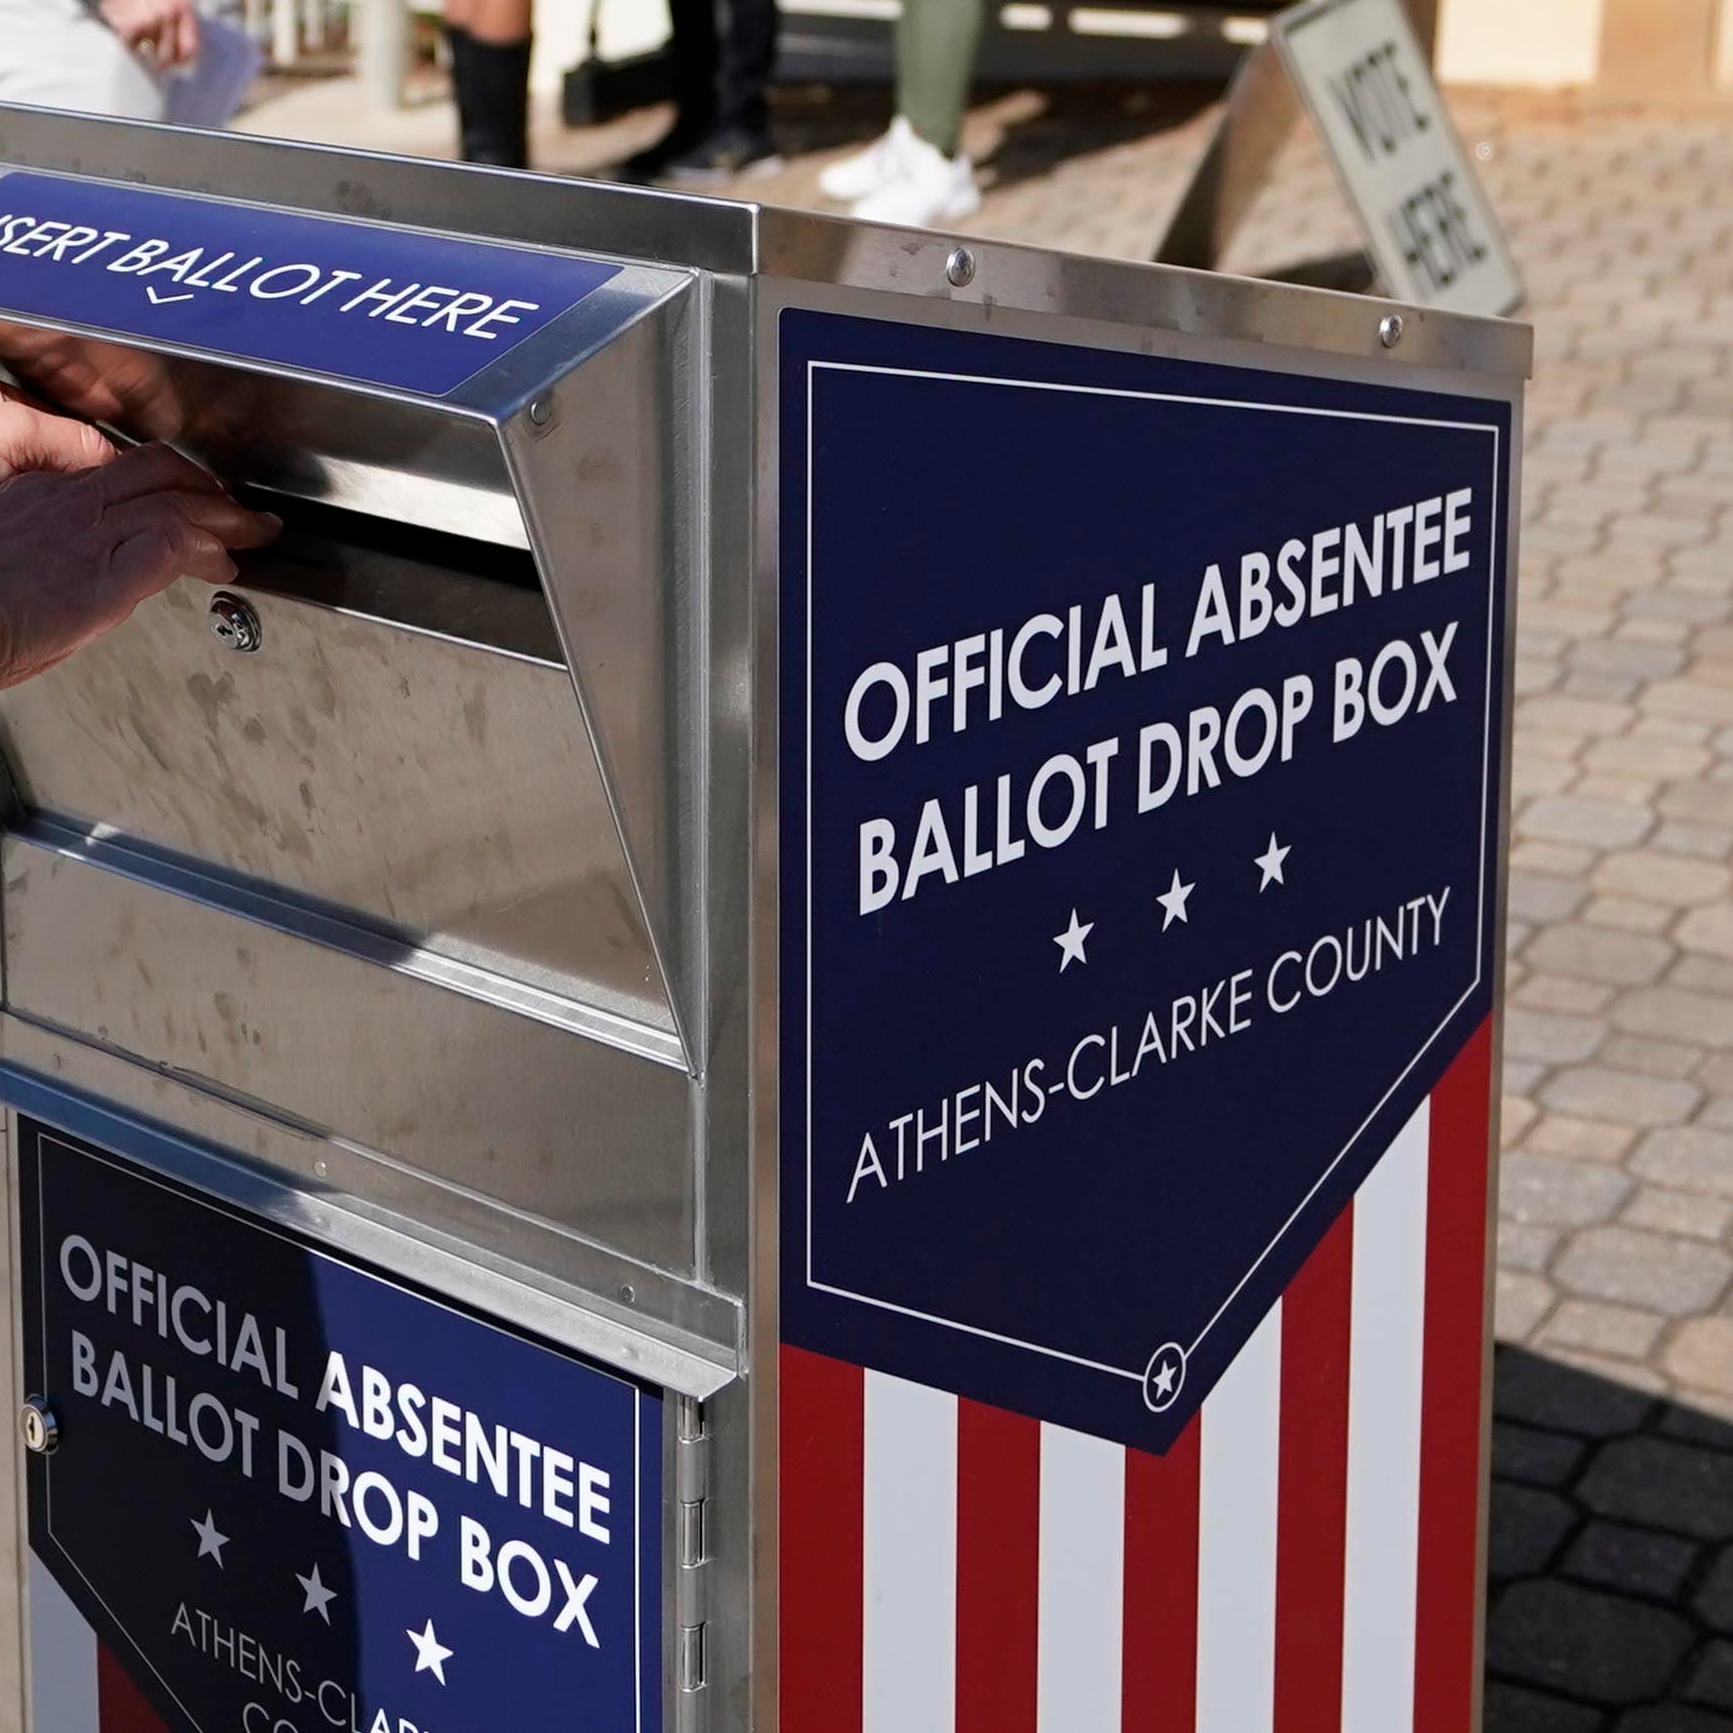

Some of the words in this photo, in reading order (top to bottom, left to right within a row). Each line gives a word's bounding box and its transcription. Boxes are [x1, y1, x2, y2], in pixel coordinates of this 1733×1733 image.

[105, 237, 364, 306] BALLOT
[338, 277, 540, 341] HERE
[844, 582, 1169, 763] OFFICIAL
[1184, 486, 1473, 659] ABSENTEE
[858, 735, 1120, 917] BALLOT
[1136, 673, 1315, 815] DROP
[1332, 620, 1460, 744] BOX
[845, 968, 1254, 1205] ATHENS-CLARKE
[1266, 885, 1452, 1014] COUNTY
[58, 1233, 300, 1401] OFFICIAL
[316, 1348, 612, 1546] ABSENTEE
[70, 1328, 261, 1480] BALLOT
[277, 1428, 441, 1563] DROP
[458, 1513, 602, 1650] BOX
[169, 1601, 431, 1733] ATHENS-CLA
